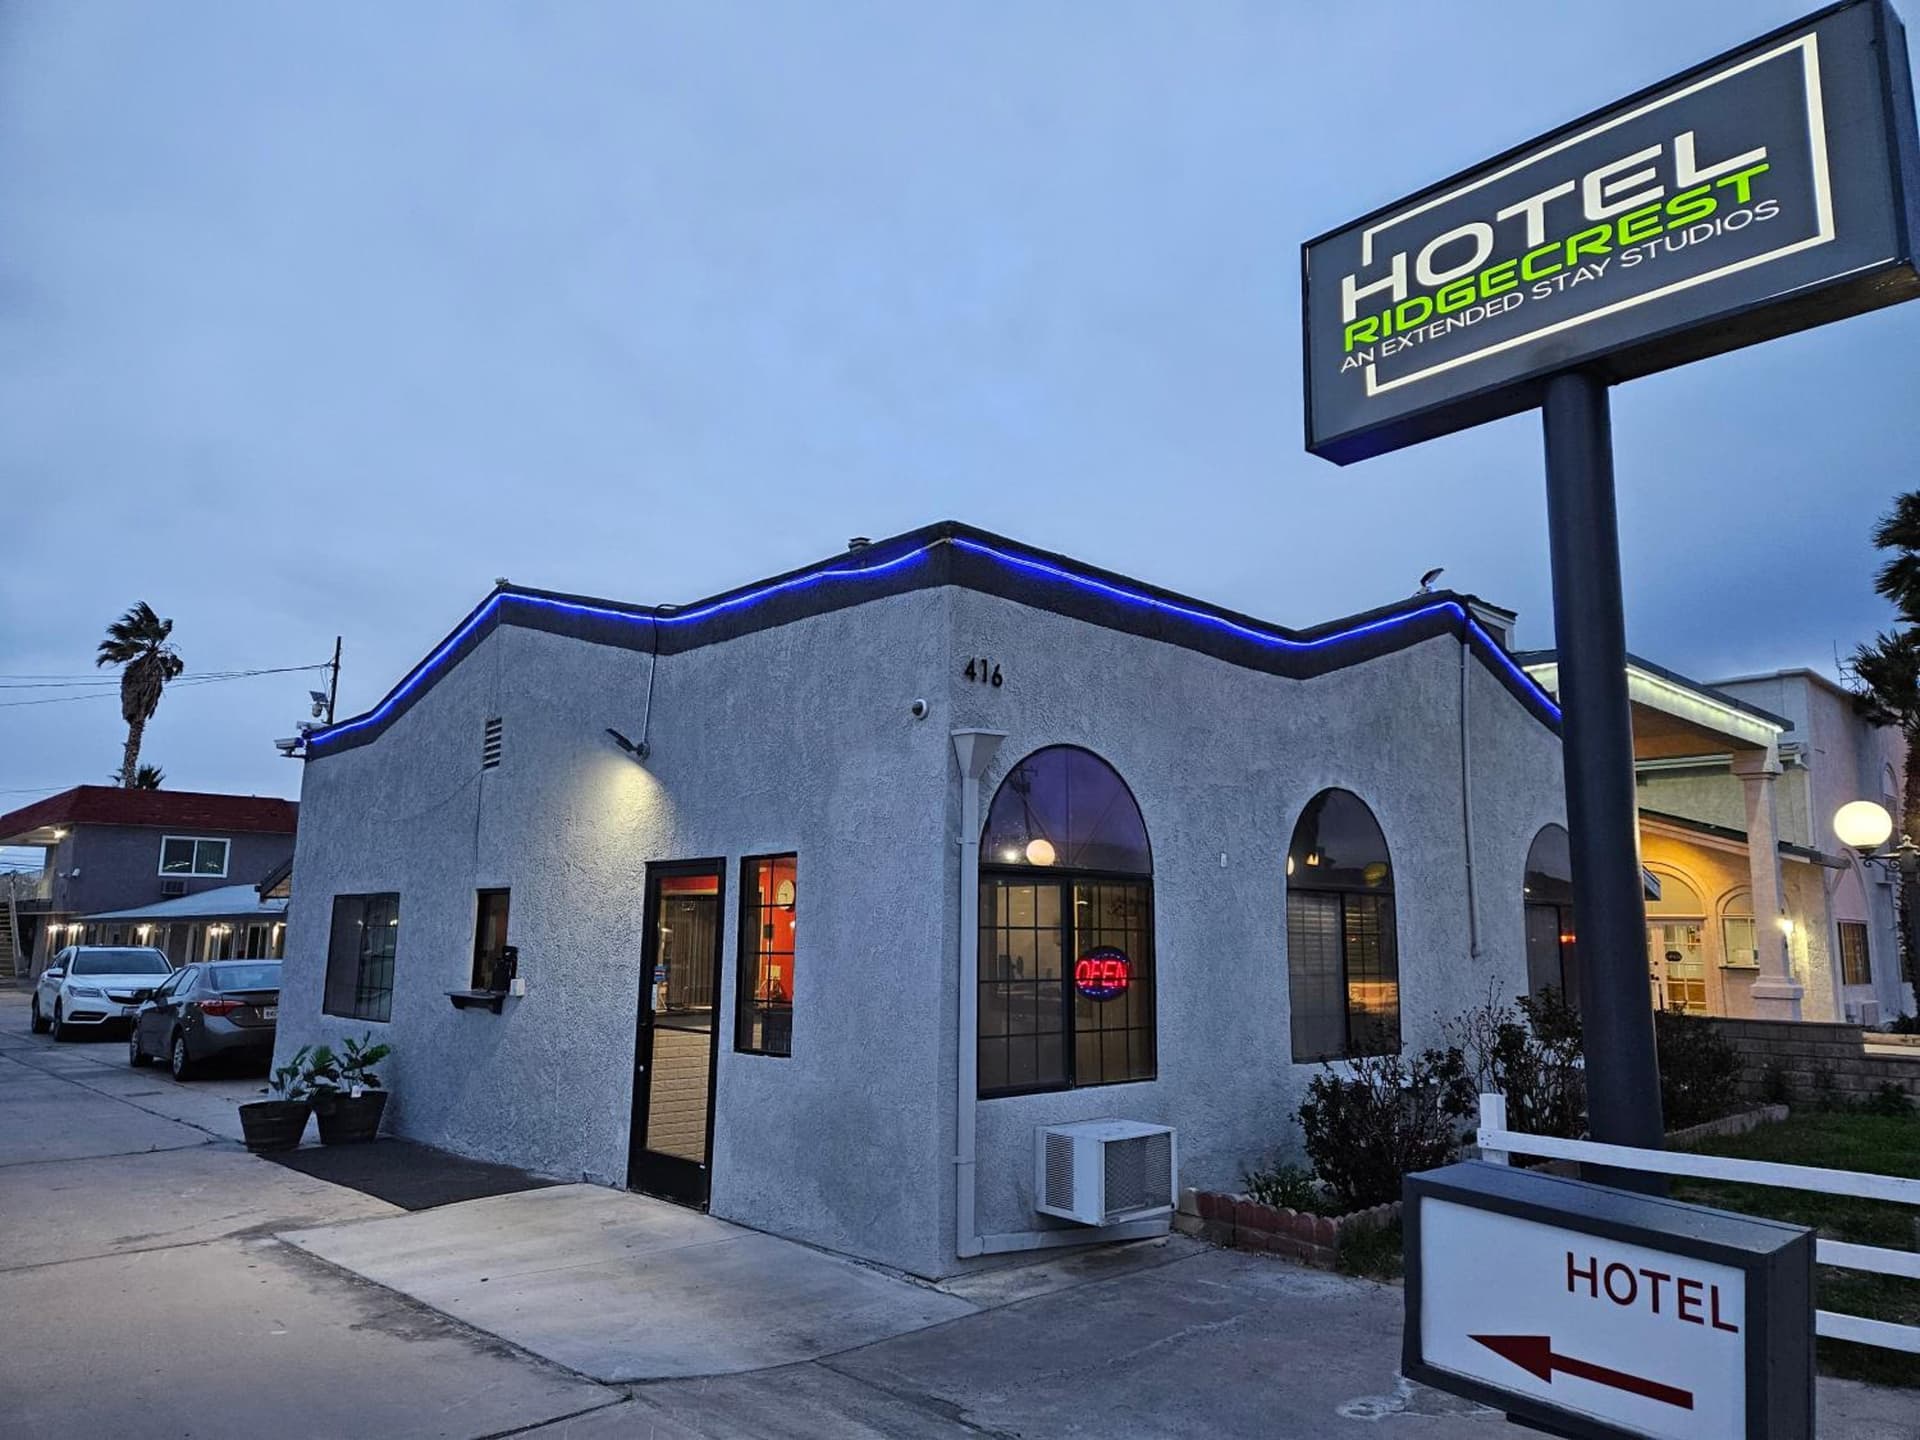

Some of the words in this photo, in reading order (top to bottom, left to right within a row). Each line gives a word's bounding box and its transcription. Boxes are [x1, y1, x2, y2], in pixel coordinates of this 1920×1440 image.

[1341, 131, 1767, 324] HOTEL
[1341, 346, 1375, 373] AN
[1381, 291, 1524, 357] EXTENDED
[1532, 257, 1611, 300] STAY
[1620, 199, 1780, 267] STUDIOS
[1344, 163, 1770, 352] RIDGECREST
[964, 657, 1003, 688] 416
[1075, 960, 1128, 987] OPEN
[1566, 1251, 1739, 1334] HOTEL
